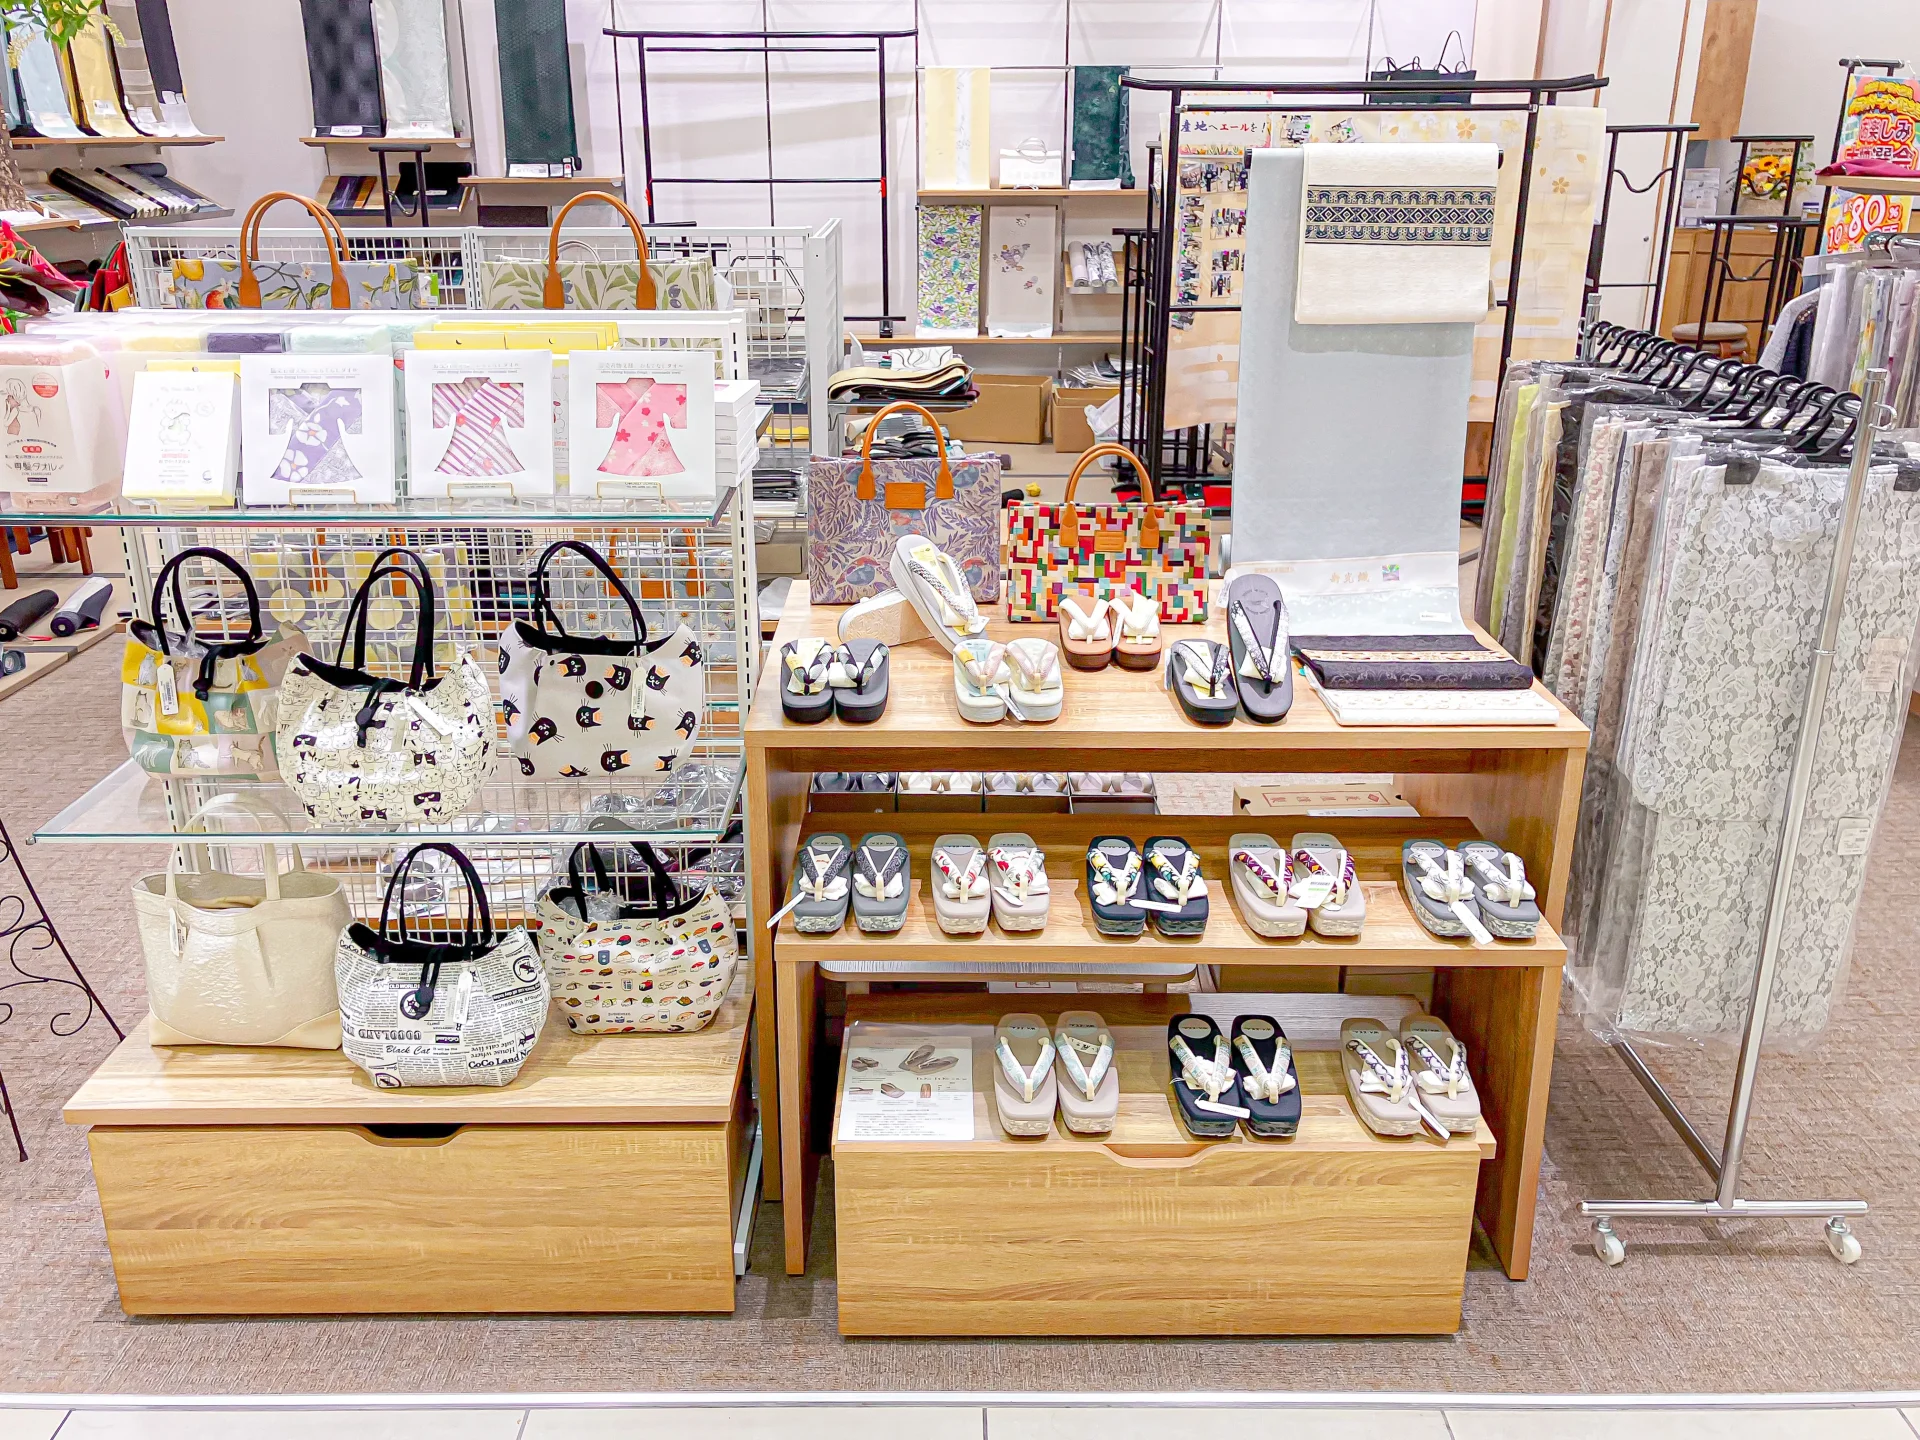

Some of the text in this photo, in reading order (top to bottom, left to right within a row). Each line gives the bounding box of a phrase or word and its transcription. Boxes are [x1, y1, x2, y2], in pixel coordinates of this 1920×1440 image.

[386, 1045, 430, 1055] Black Cat
[468, 1059, 494, 1069] CoCo
[496, 1054, 520, 1066] Land
